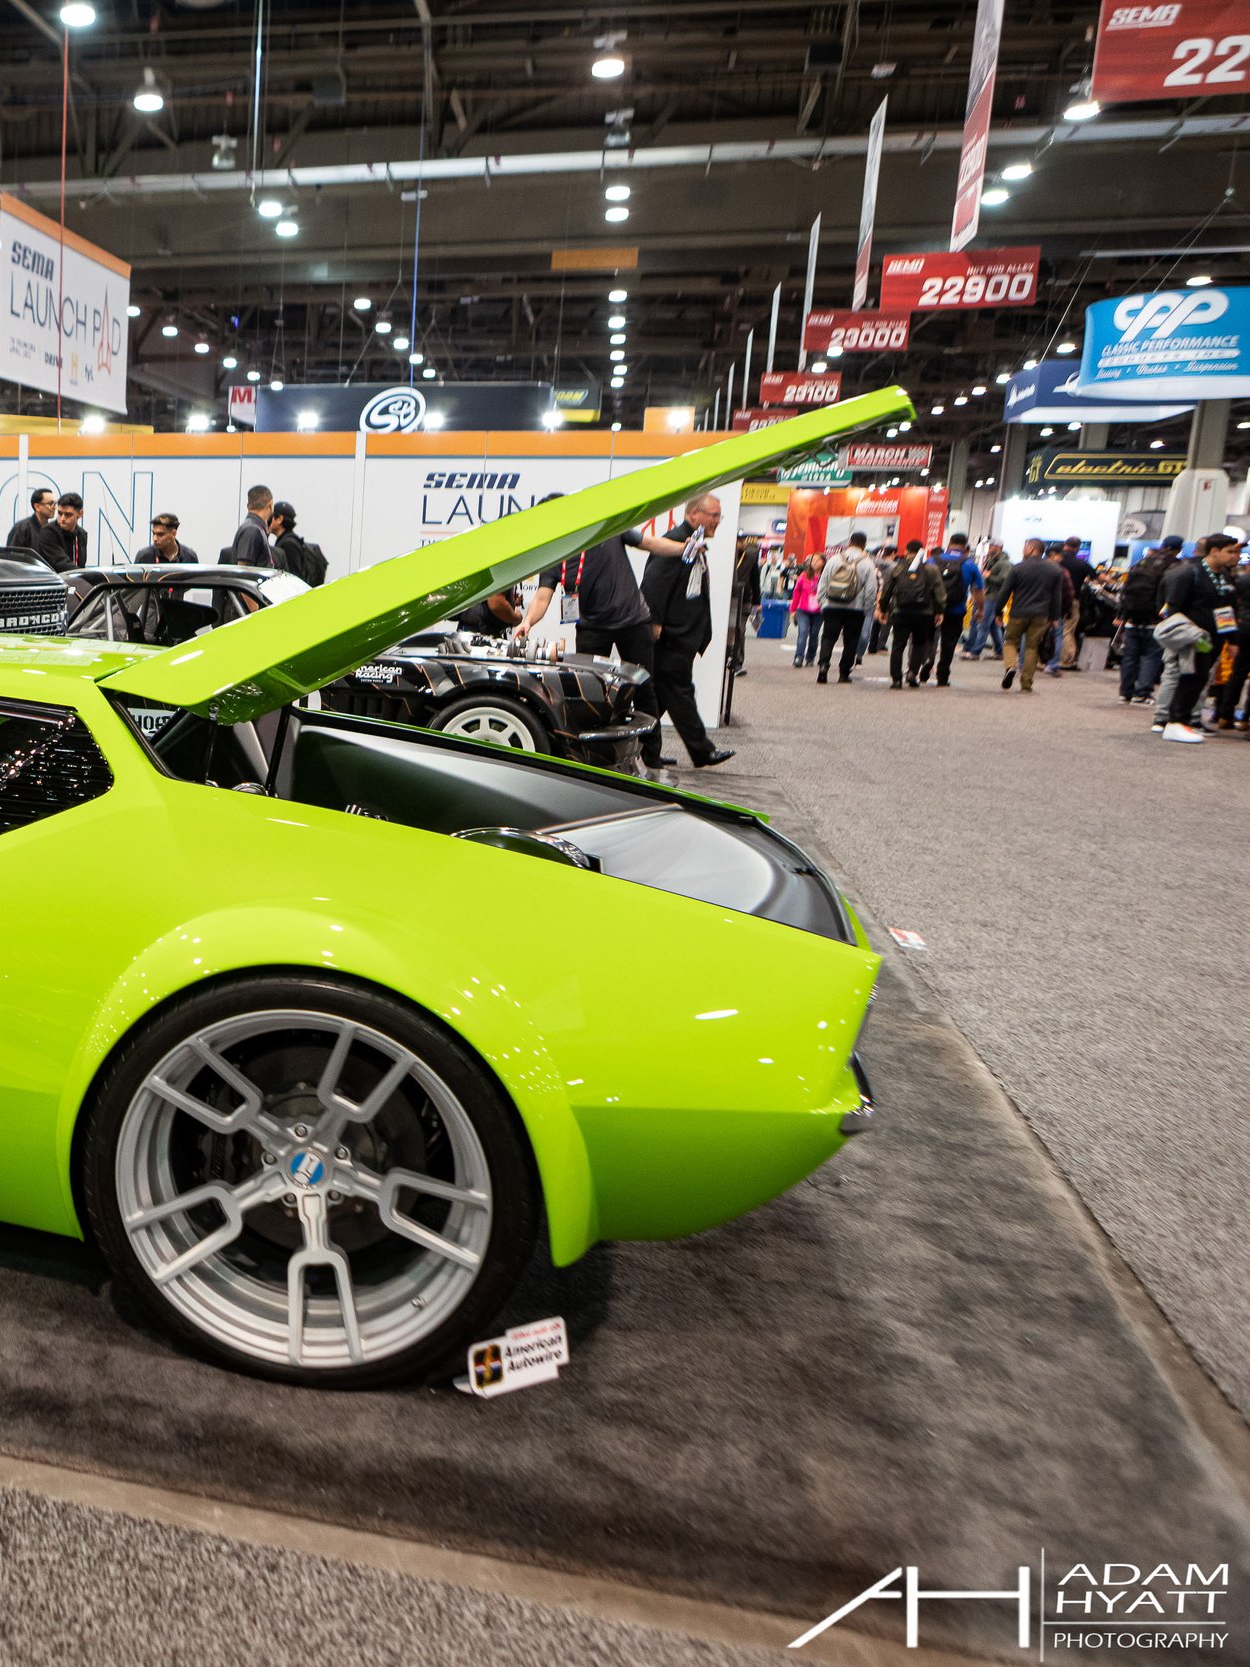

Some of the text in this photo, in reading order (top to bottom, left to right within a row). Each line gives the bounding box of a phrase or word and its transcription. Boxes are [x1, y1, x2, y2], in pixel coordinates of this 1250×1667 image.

[1110, 4, 1181, 27] SEMA
[11, 240, 54, 281] SEMA
[917, 273, 1034, 306] 22900
[9, 271, 87, 346] LAUNCH
[828, 327, 907, 349] 23000
[1101, 335, 1240, 357] CLASSIC PERFORMANCE
[423, 472, 520, 489] SEMA
[355, 671, 394, 684] Racing
[505, 1335, 562, 1357] American
